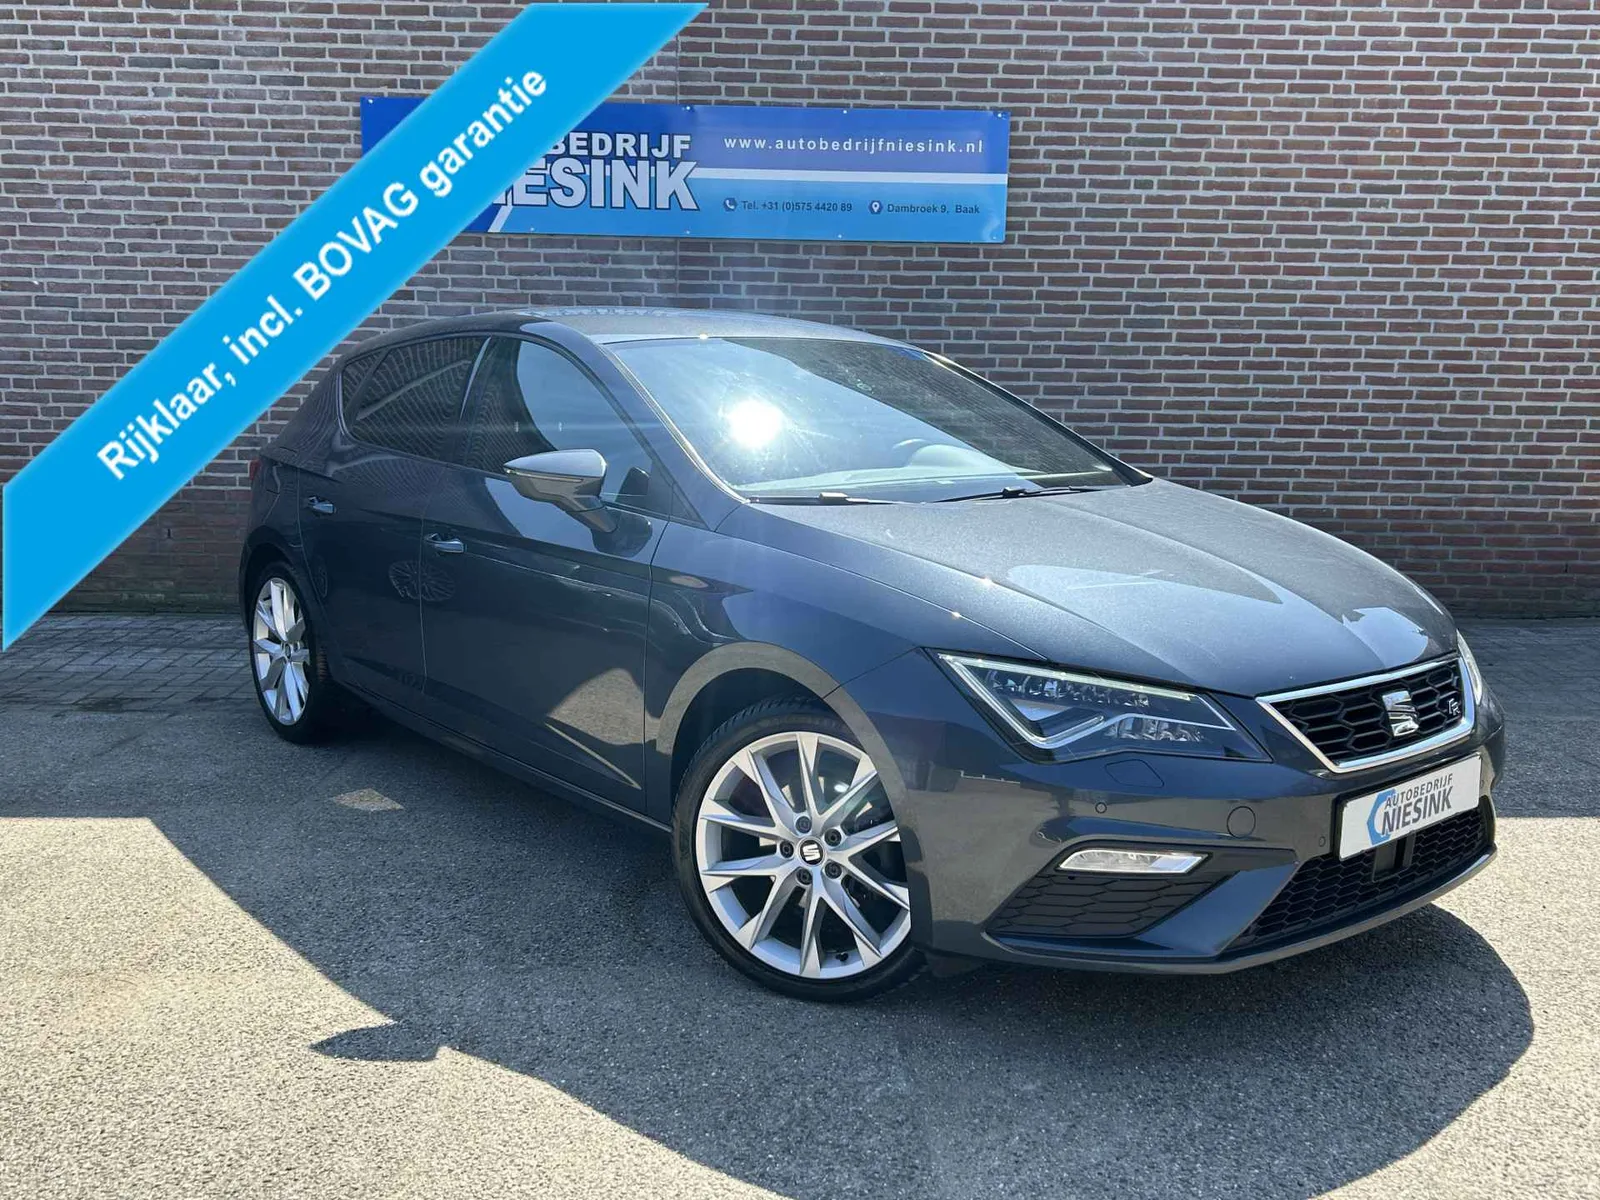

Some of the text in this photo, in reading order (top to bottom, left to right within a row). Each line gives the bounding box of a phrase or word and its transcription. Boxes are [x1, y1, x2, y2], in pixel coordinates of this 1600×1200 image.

[724, 136, 984, 154] www.autobedrijfniesink.nl
[494, 157, 699, 211] ESINK
[742, 200, 853, 212] Tel. +31 (0)575 4420 89
[887, 203, 938, 213] Dambroek
[955, 204, 980, 214] Baak
[1384, 773, 1454, 811] AUTOBEDRIJF
[1381, 785, 1454, 836] NIESINK
